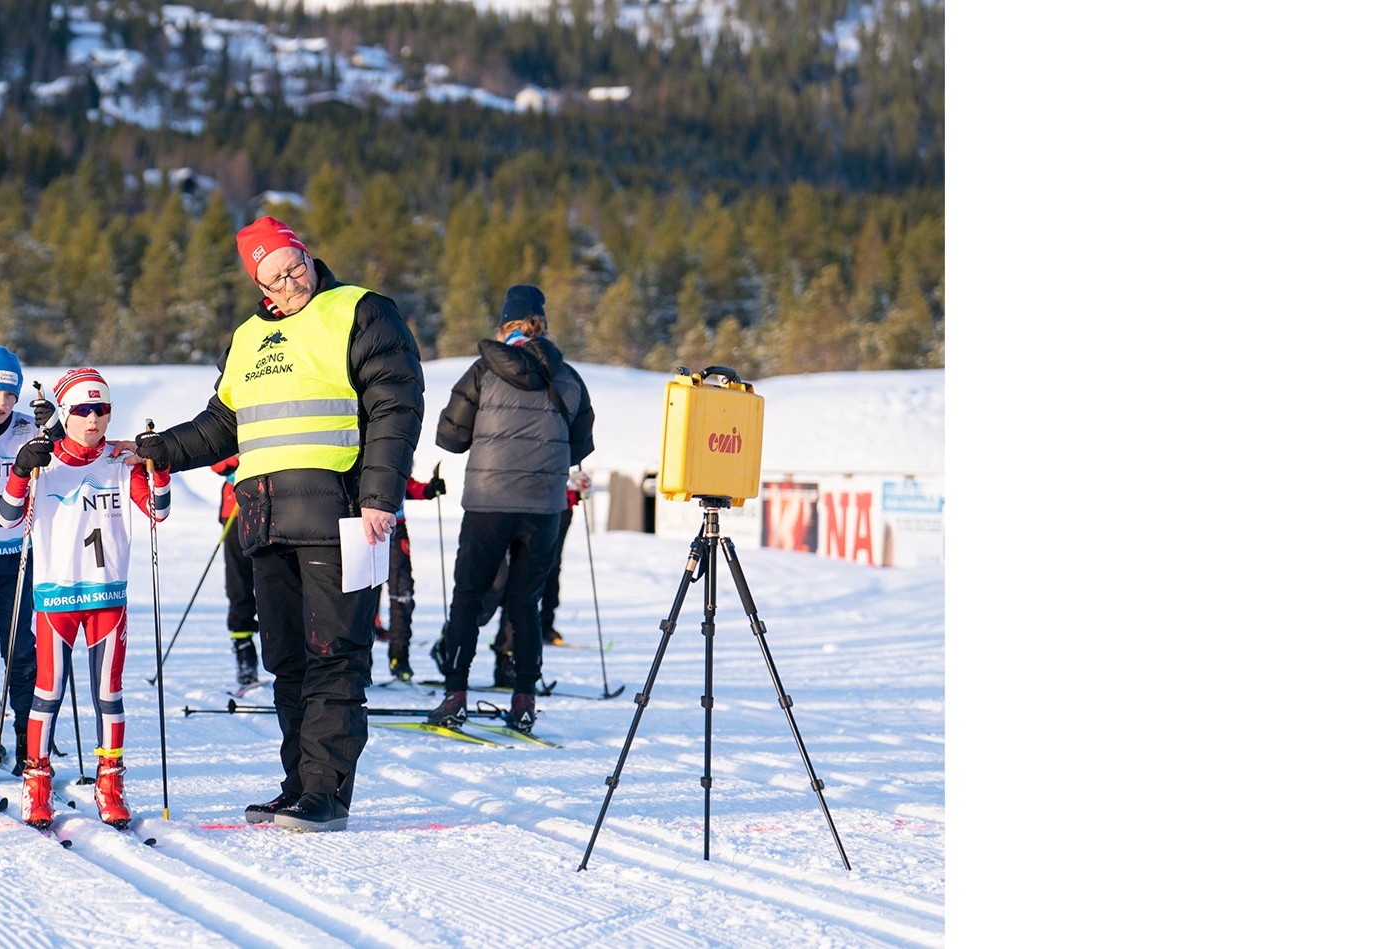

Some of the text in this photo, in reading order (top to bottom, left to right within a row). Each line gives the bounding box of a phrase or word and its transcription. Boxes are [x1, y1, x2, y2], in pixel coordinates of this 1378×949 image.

[708, 426, 743, 454] emit
[82, 493, 121, 512] NTE
[84, 527, 106, 568] 1
[43, 592, 91, 607] BJØRGAN
